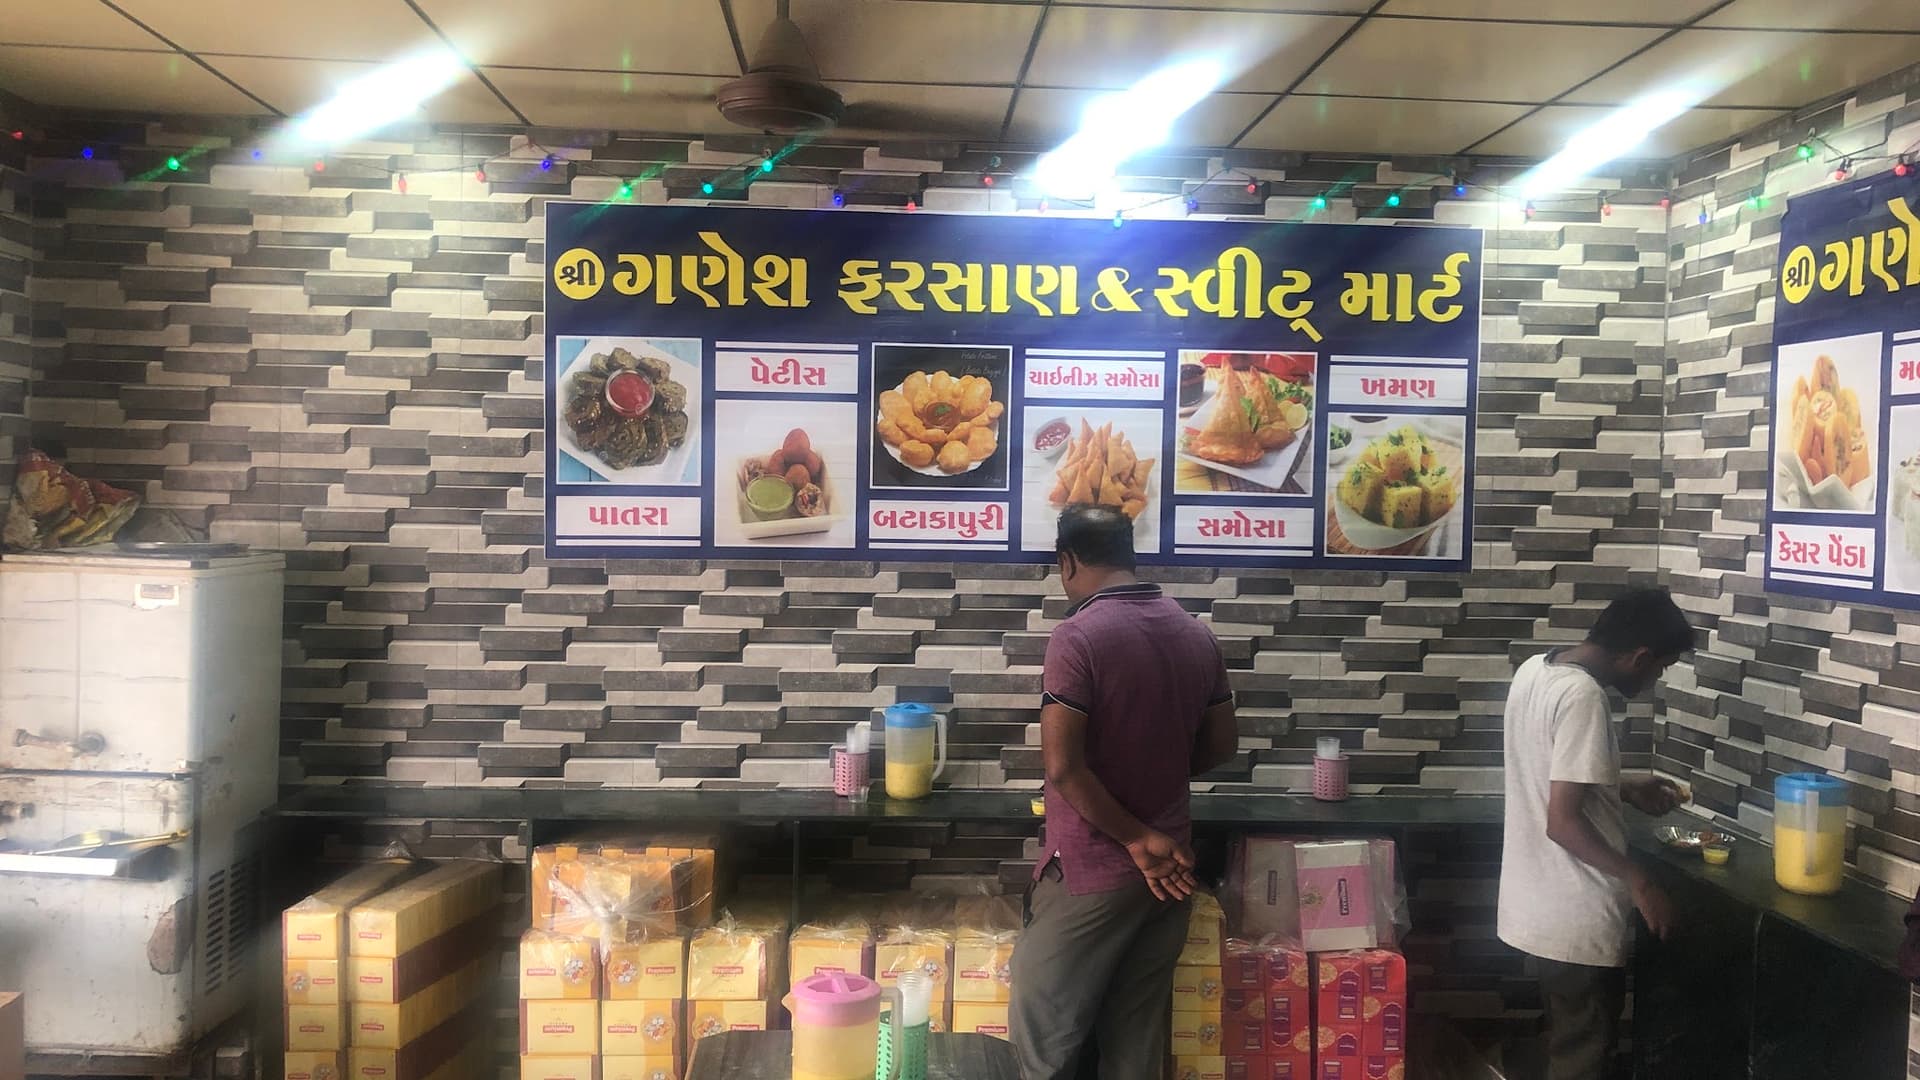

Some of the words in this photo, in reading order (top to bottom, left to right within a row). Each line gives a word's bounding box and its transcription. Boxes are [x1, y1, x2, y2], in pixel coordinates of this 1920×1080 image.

[558, 258, 597, 286] શ્રી
[612, 231, 811, 308] ગણેશ
[837, 259, 1081, 316] ફરસાણ
[1091, 266, 1143, 312] &
[1340, 252, 1469, 323] માર્ટ
[751, 357, 828, 386] પેટીસ
[1029, 366, 1098, 386] ચાઈનીઝ
[1104, 367, 1160, 388] સમોસા
[1899, 360, 1920, 381] મ
[1360, 377, 1437, 398] ખમણ
[588, 506, 669, 526] પાતરા
[872, 503, 1005, 539] બટાકાપુરી
[1197, 510, 1287, 539] સમોસા
[1778, 531, 1821, 565] કેસર
[1827, 533, 1866, 569] પેંડા
